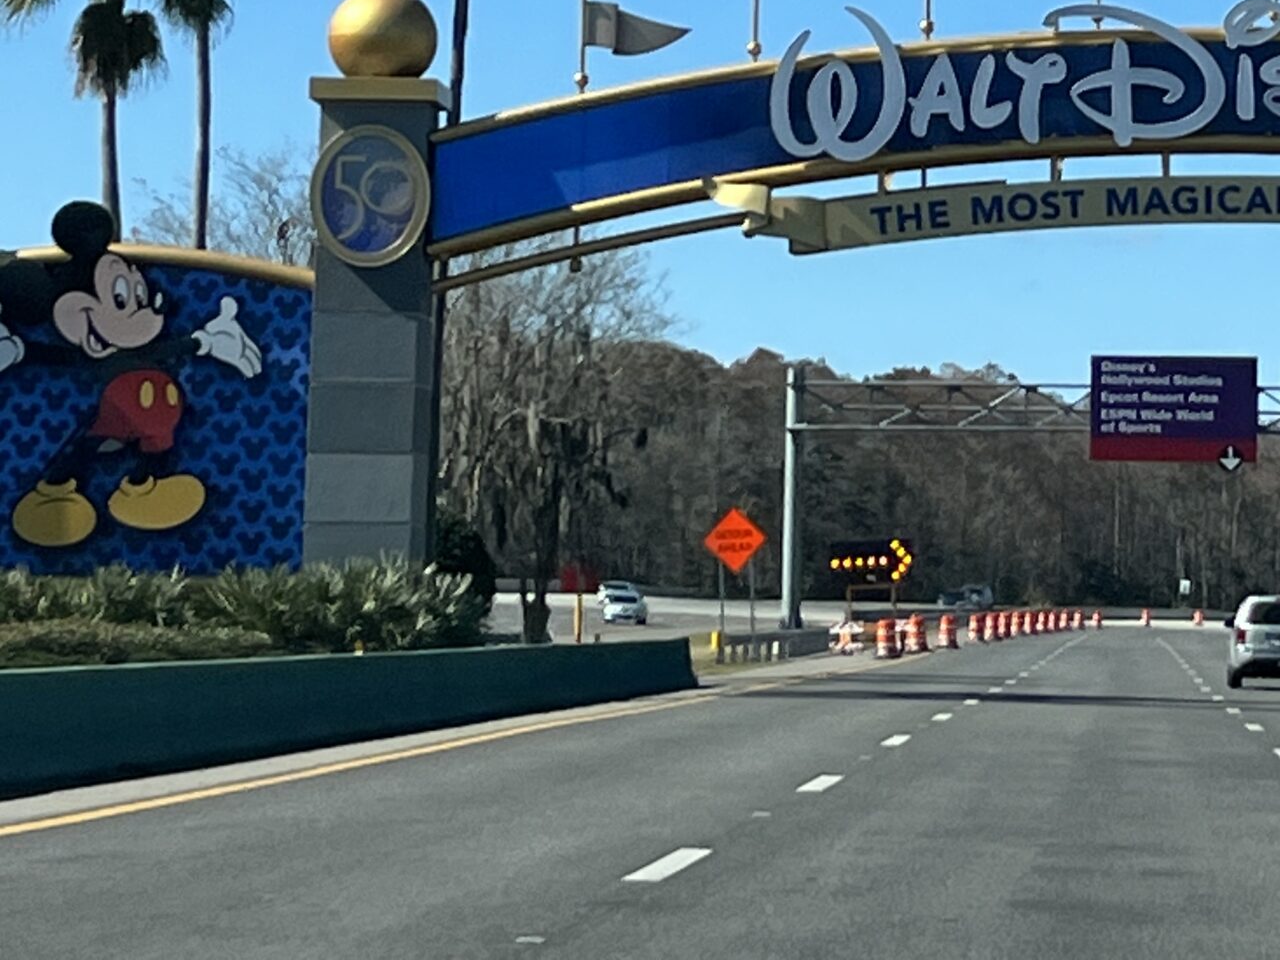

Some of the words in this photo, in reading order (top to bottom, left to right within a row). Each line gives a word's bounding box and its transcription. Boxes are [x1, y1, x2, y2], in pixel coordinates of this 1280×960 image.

[335, 154, 416, 239] 50
[870, 200, 951, 235] THE
[971, 189, 1085, 225] MOST
[1188, 392, 1219, 403] Area
